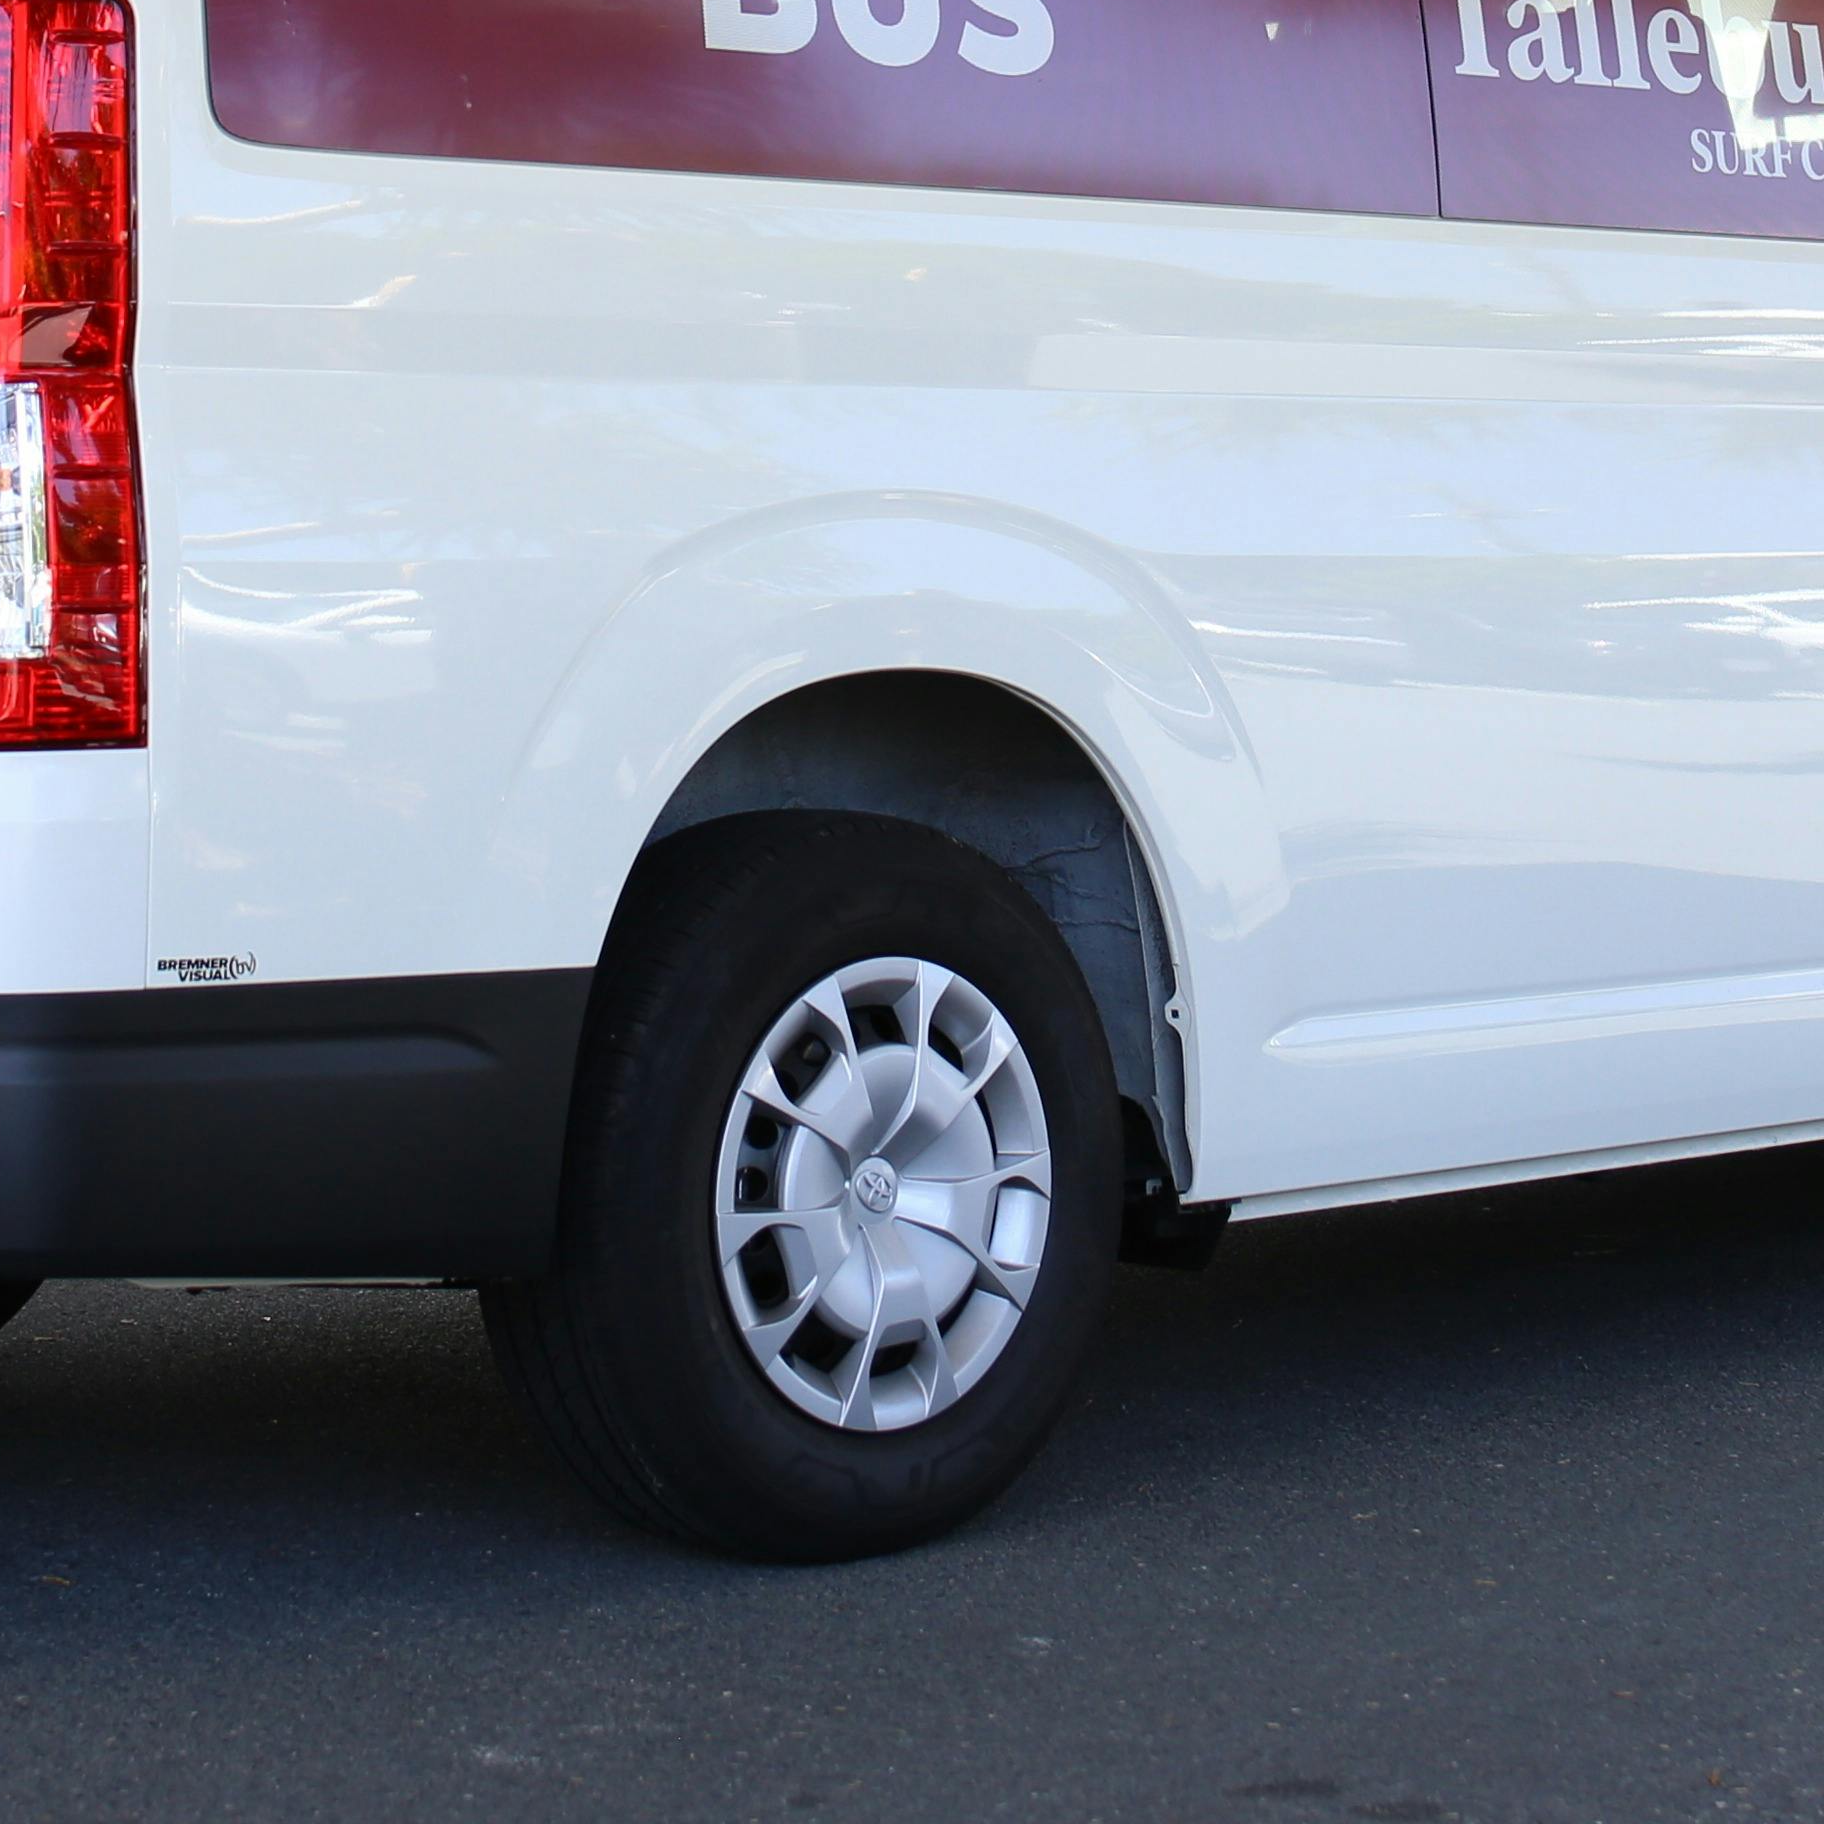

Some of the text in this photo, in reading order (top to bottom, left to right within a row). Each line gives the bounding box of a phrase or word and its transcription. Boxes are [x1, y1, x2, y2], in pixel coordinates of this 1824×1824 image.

[1690, 128, 1793, 178] SURF
[157, 957, 229, 972] BREMNER
[178, 969, 230, 983] VISUAL
